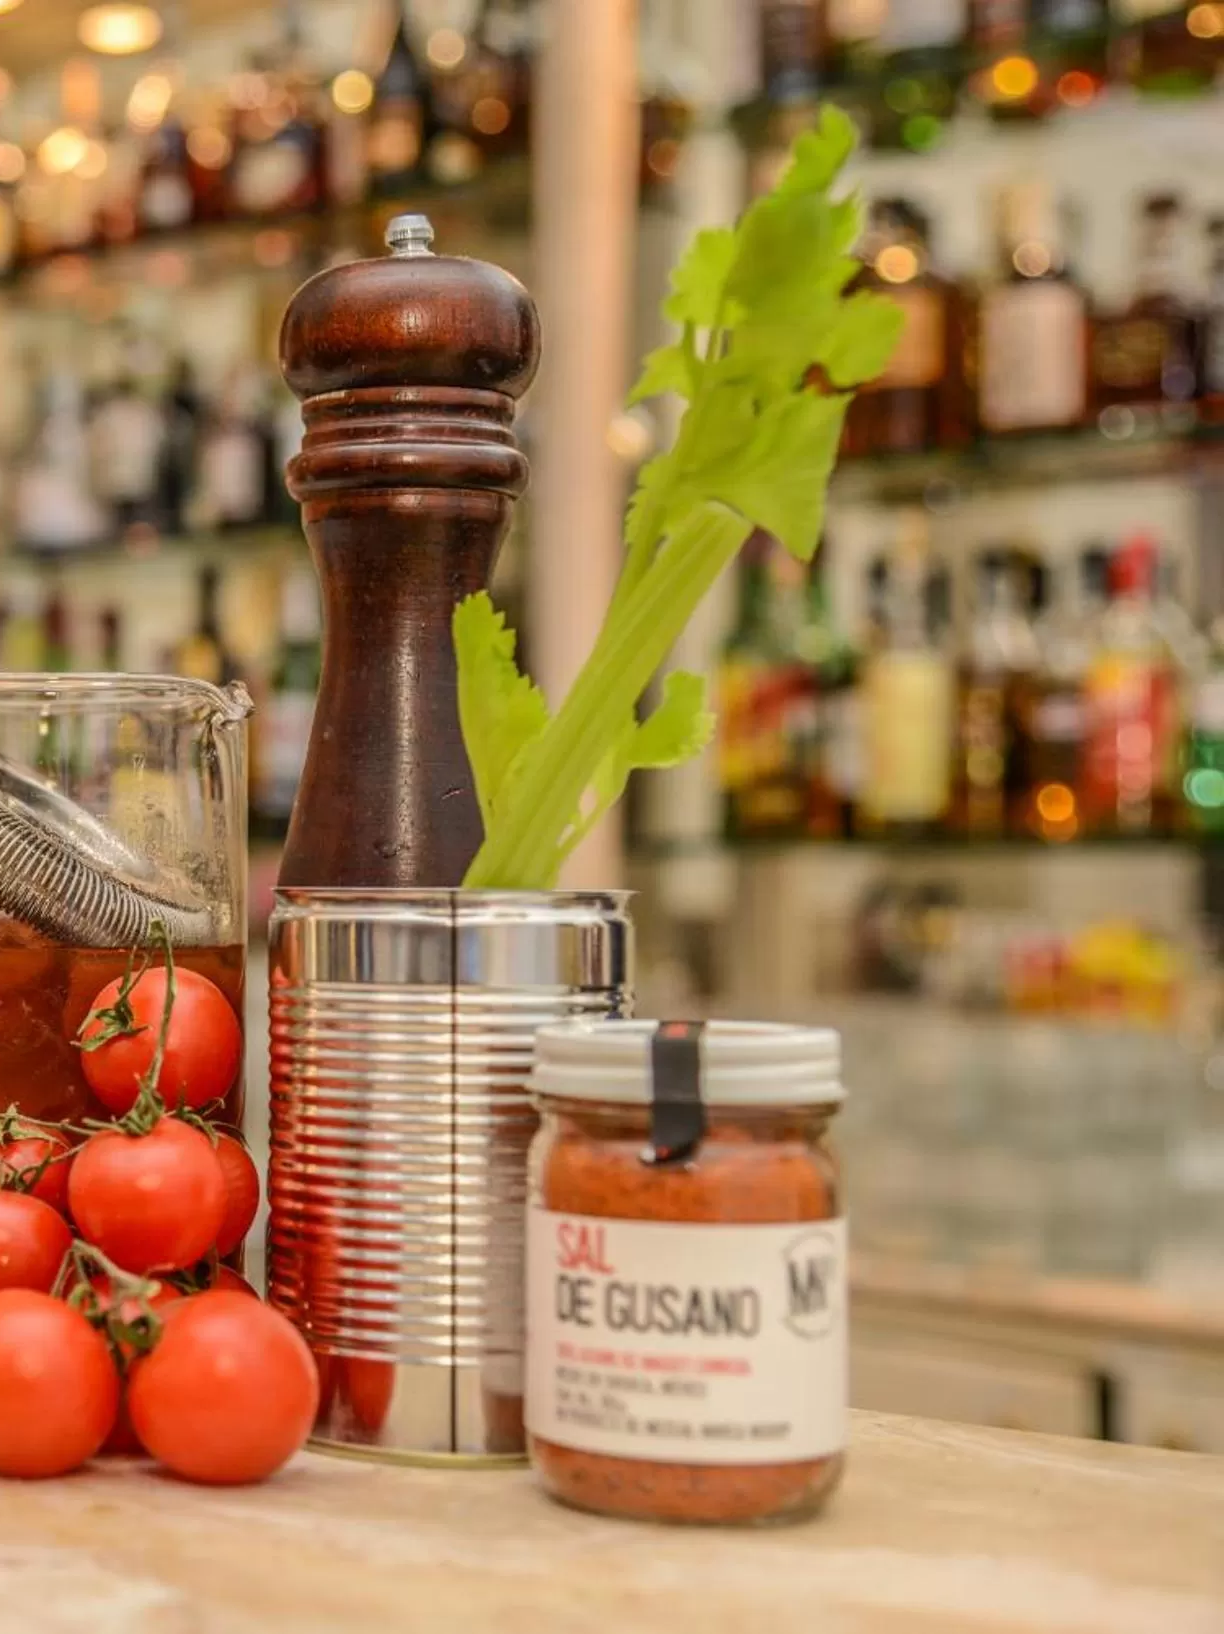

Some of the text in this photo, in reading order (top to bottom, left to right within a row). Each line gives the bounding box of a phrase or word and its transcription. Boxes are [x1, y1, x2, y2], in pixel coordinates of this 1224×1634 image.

[556, 1223, 615, 1275] SAL
[556, 1273, 761, 1338] DE GUSANO
